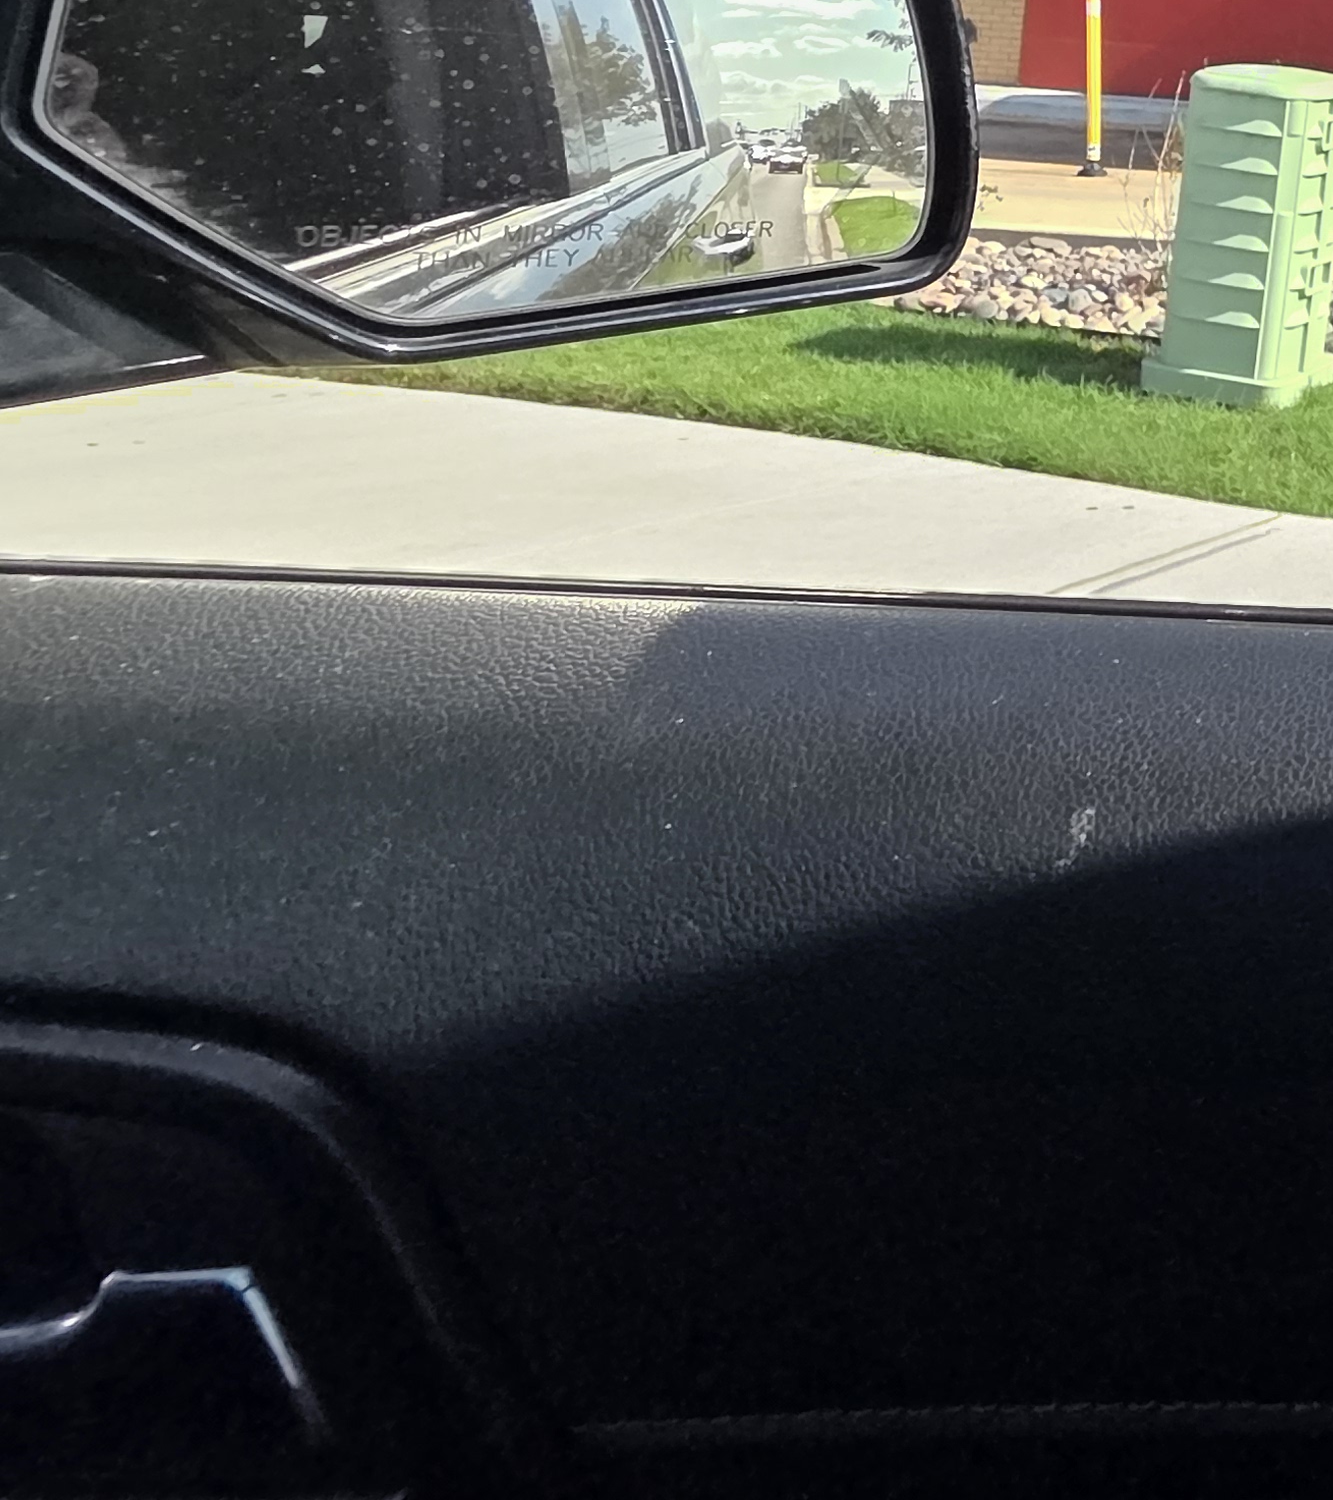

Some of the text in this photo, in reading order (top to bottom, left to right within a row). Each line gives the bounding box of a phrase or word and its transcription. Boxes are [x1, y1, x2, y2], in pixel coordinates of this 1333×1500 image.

[456, 223, 481, 244] IN
[504, 223, 604, 242] MIRROR
[686, 221, 774, 239] CLOSER
[413, 251, 491, 270] THAN
[509, 249, 579, 268] THEY
